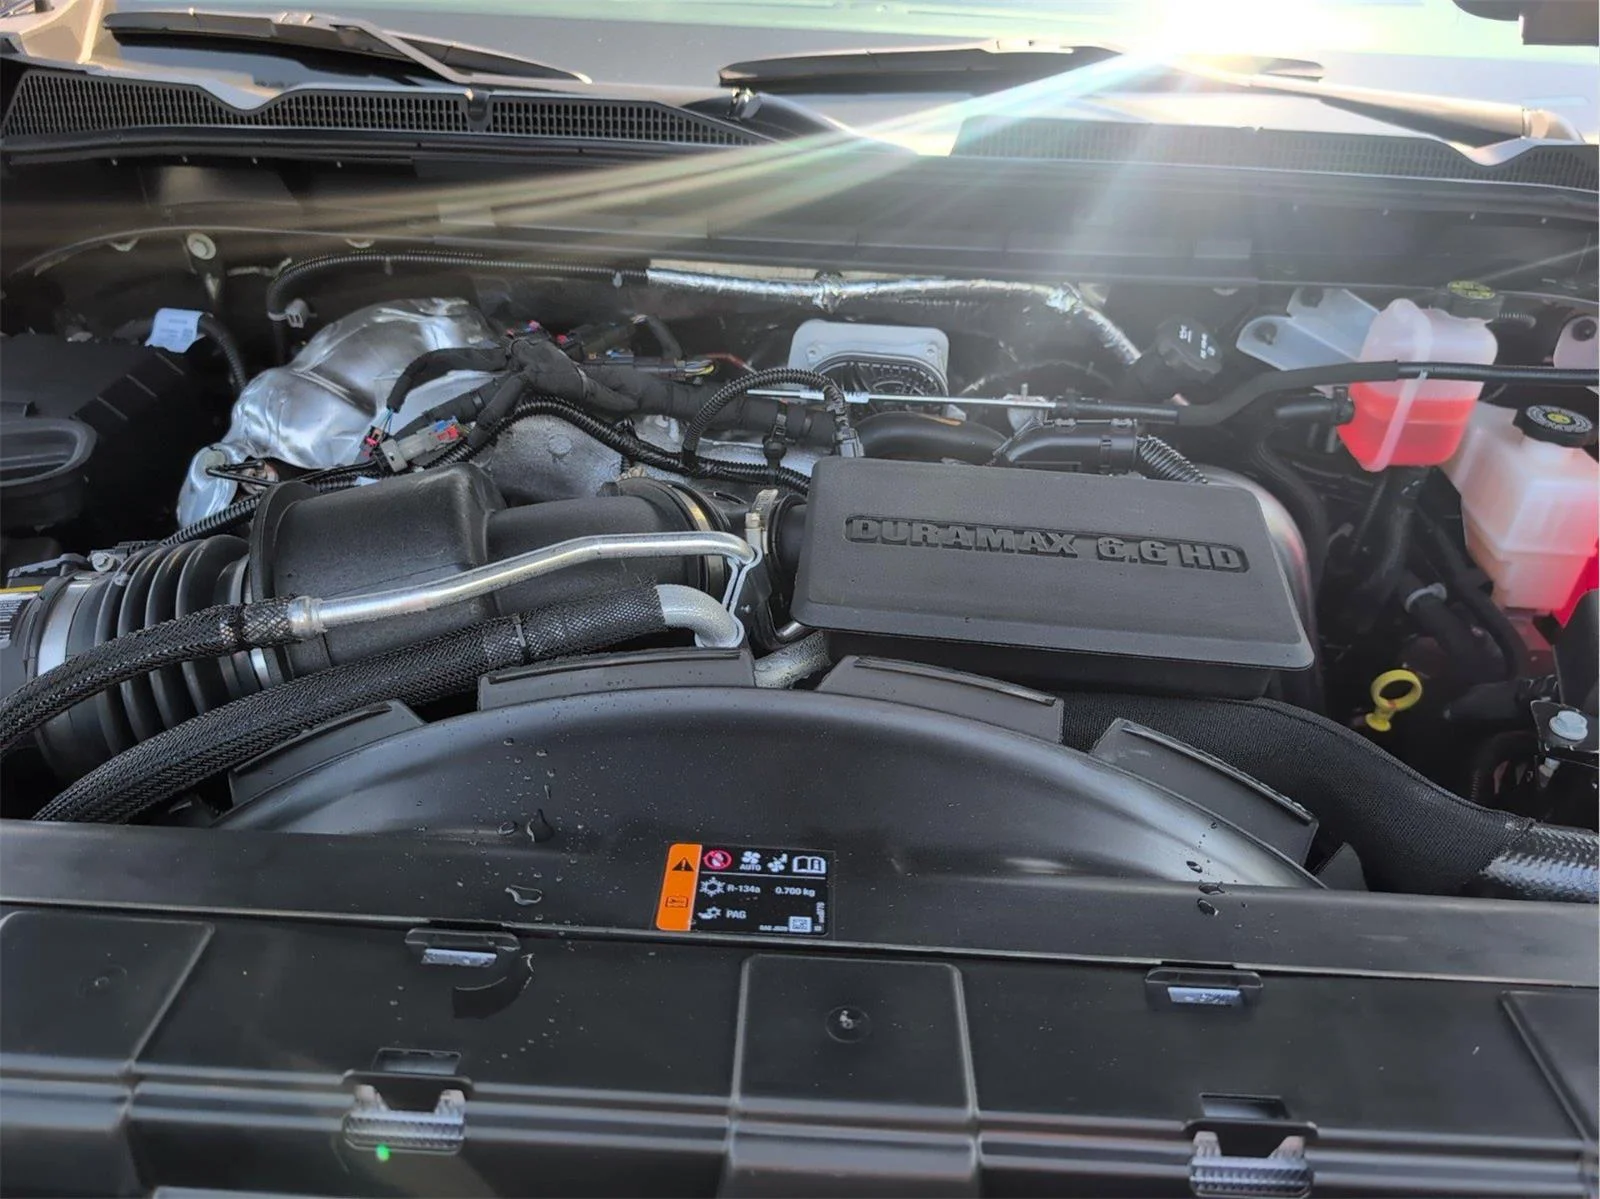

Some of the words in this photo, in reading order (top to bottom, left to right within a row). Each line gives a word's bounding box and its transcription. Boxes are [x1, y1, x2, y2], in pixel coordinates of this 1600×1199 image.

[850, 517, 1078, 558] DURAMAX
[1096, 536, 1169, 565] 6.6
[1178, 542, 1245, 574] HD
[727, 885, 761, 893] R-134a
[775, 886, 801, 895] 0.700
[803, 888, 816, 897] kg
[726, 909, 747, 919] PAG
